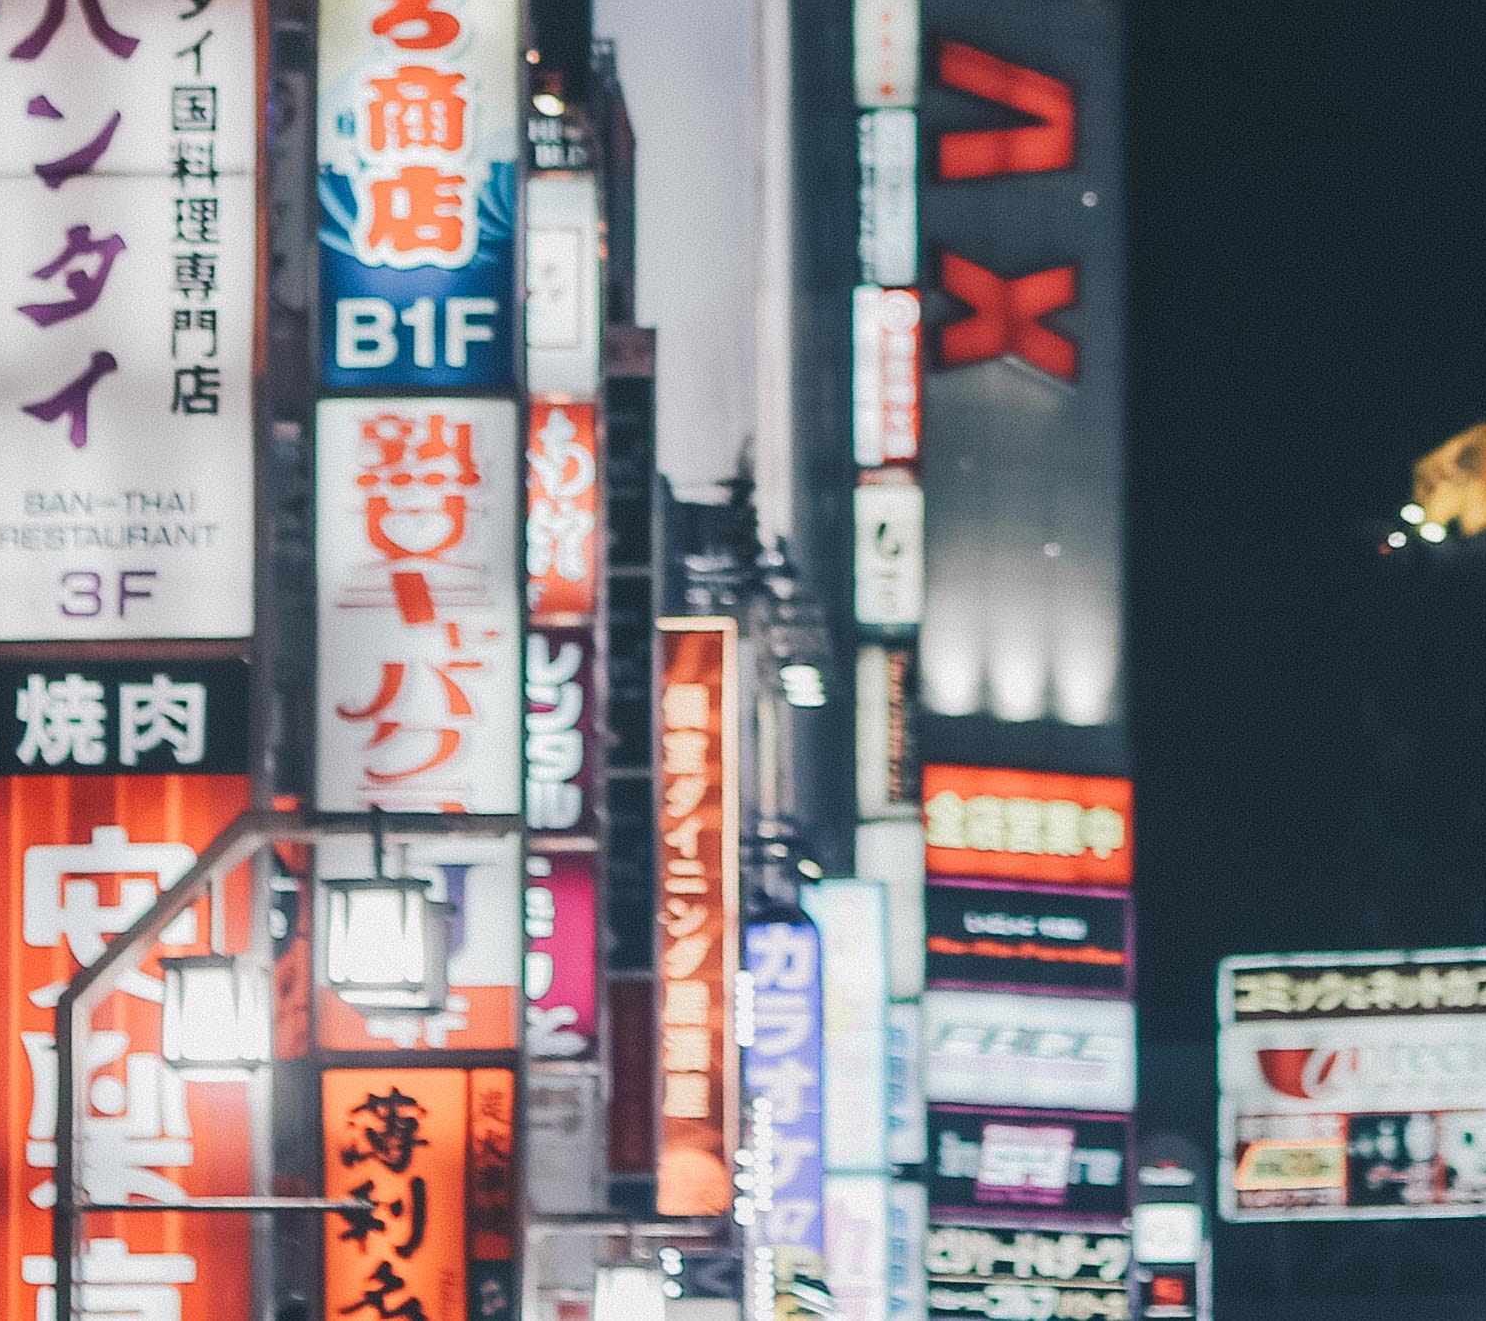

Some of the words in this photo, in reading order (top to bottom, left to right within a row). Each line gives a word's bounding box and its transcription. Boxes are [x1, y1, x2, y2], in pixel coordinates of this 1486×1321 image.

[335, 297, 499, 370] B1F
[22, 489, 196, 517] BAN-THAI
[59, 571, 158, 620] 3F
[15, 673, 208, 767] 焼肉
